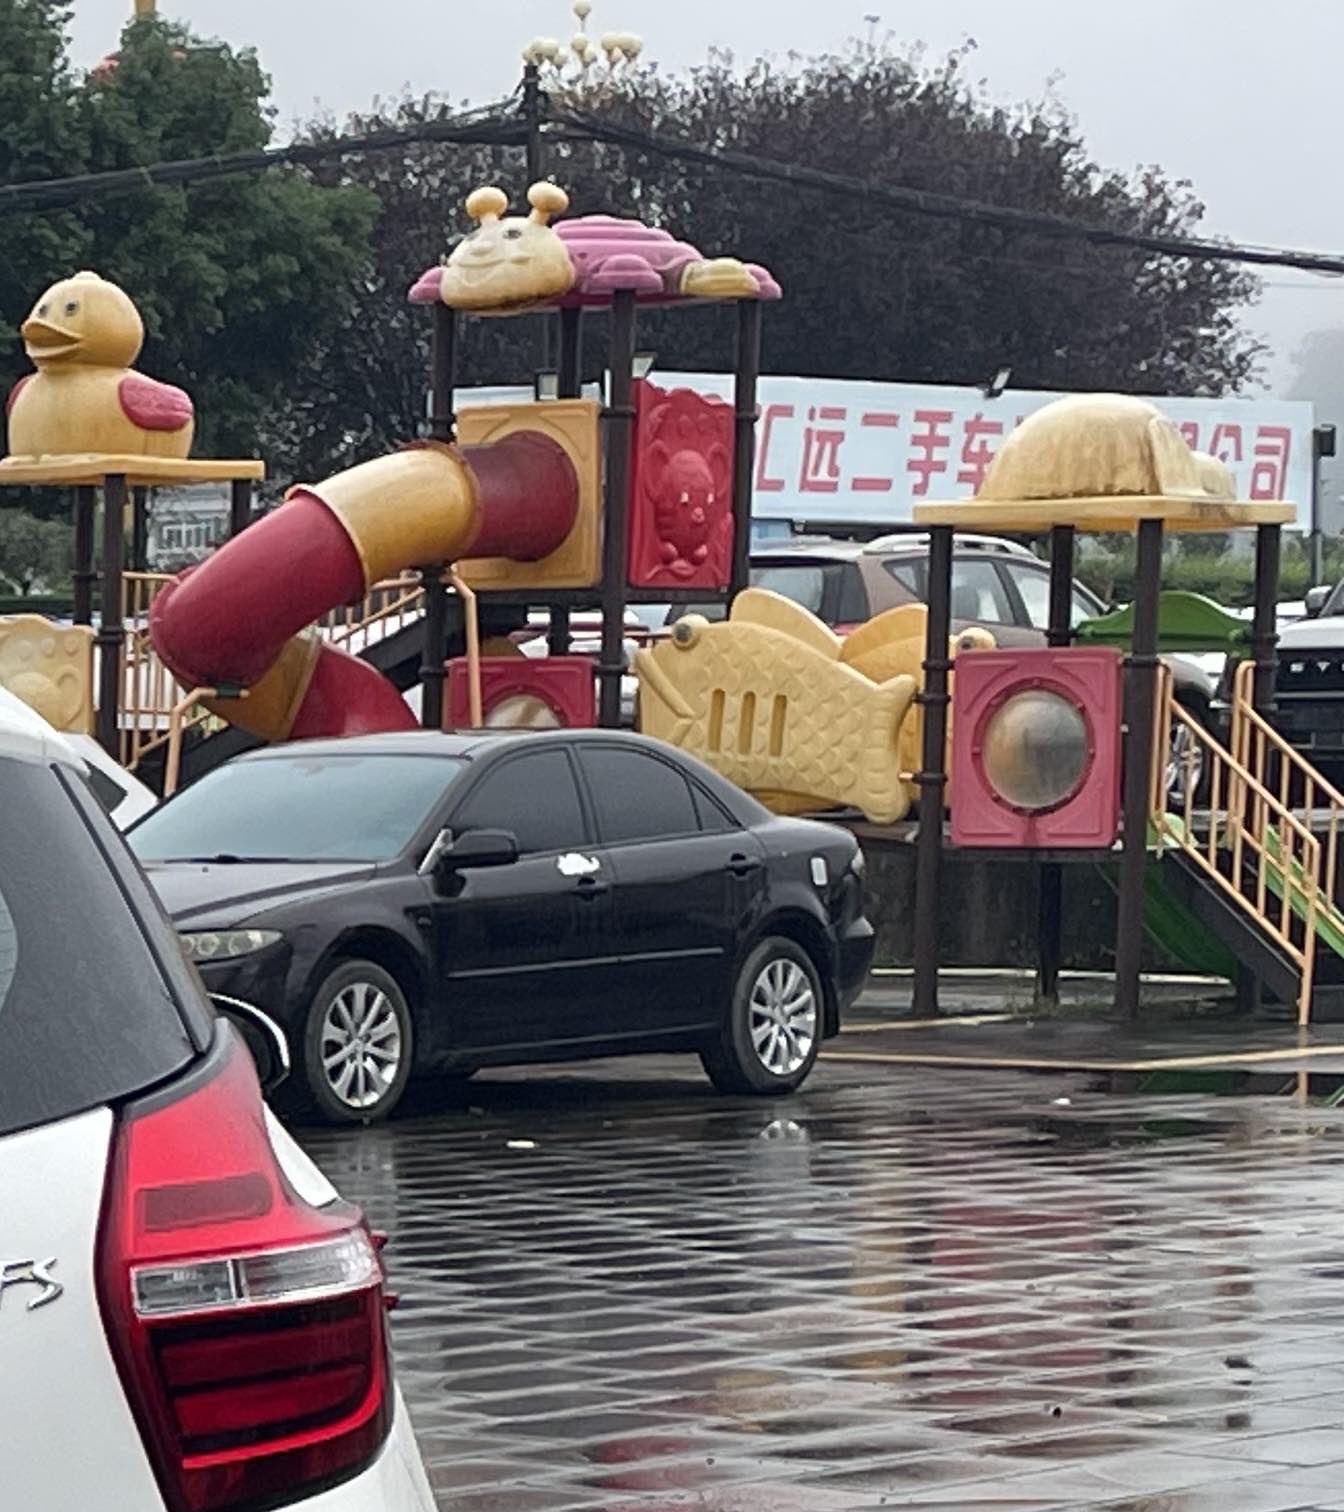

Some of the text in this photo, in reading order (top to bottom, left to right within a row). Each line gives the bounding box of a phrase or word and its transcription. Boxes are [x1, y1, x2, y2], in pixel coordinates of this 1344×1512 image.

[755, 404, 1292, 501] 汇远二手车公司
